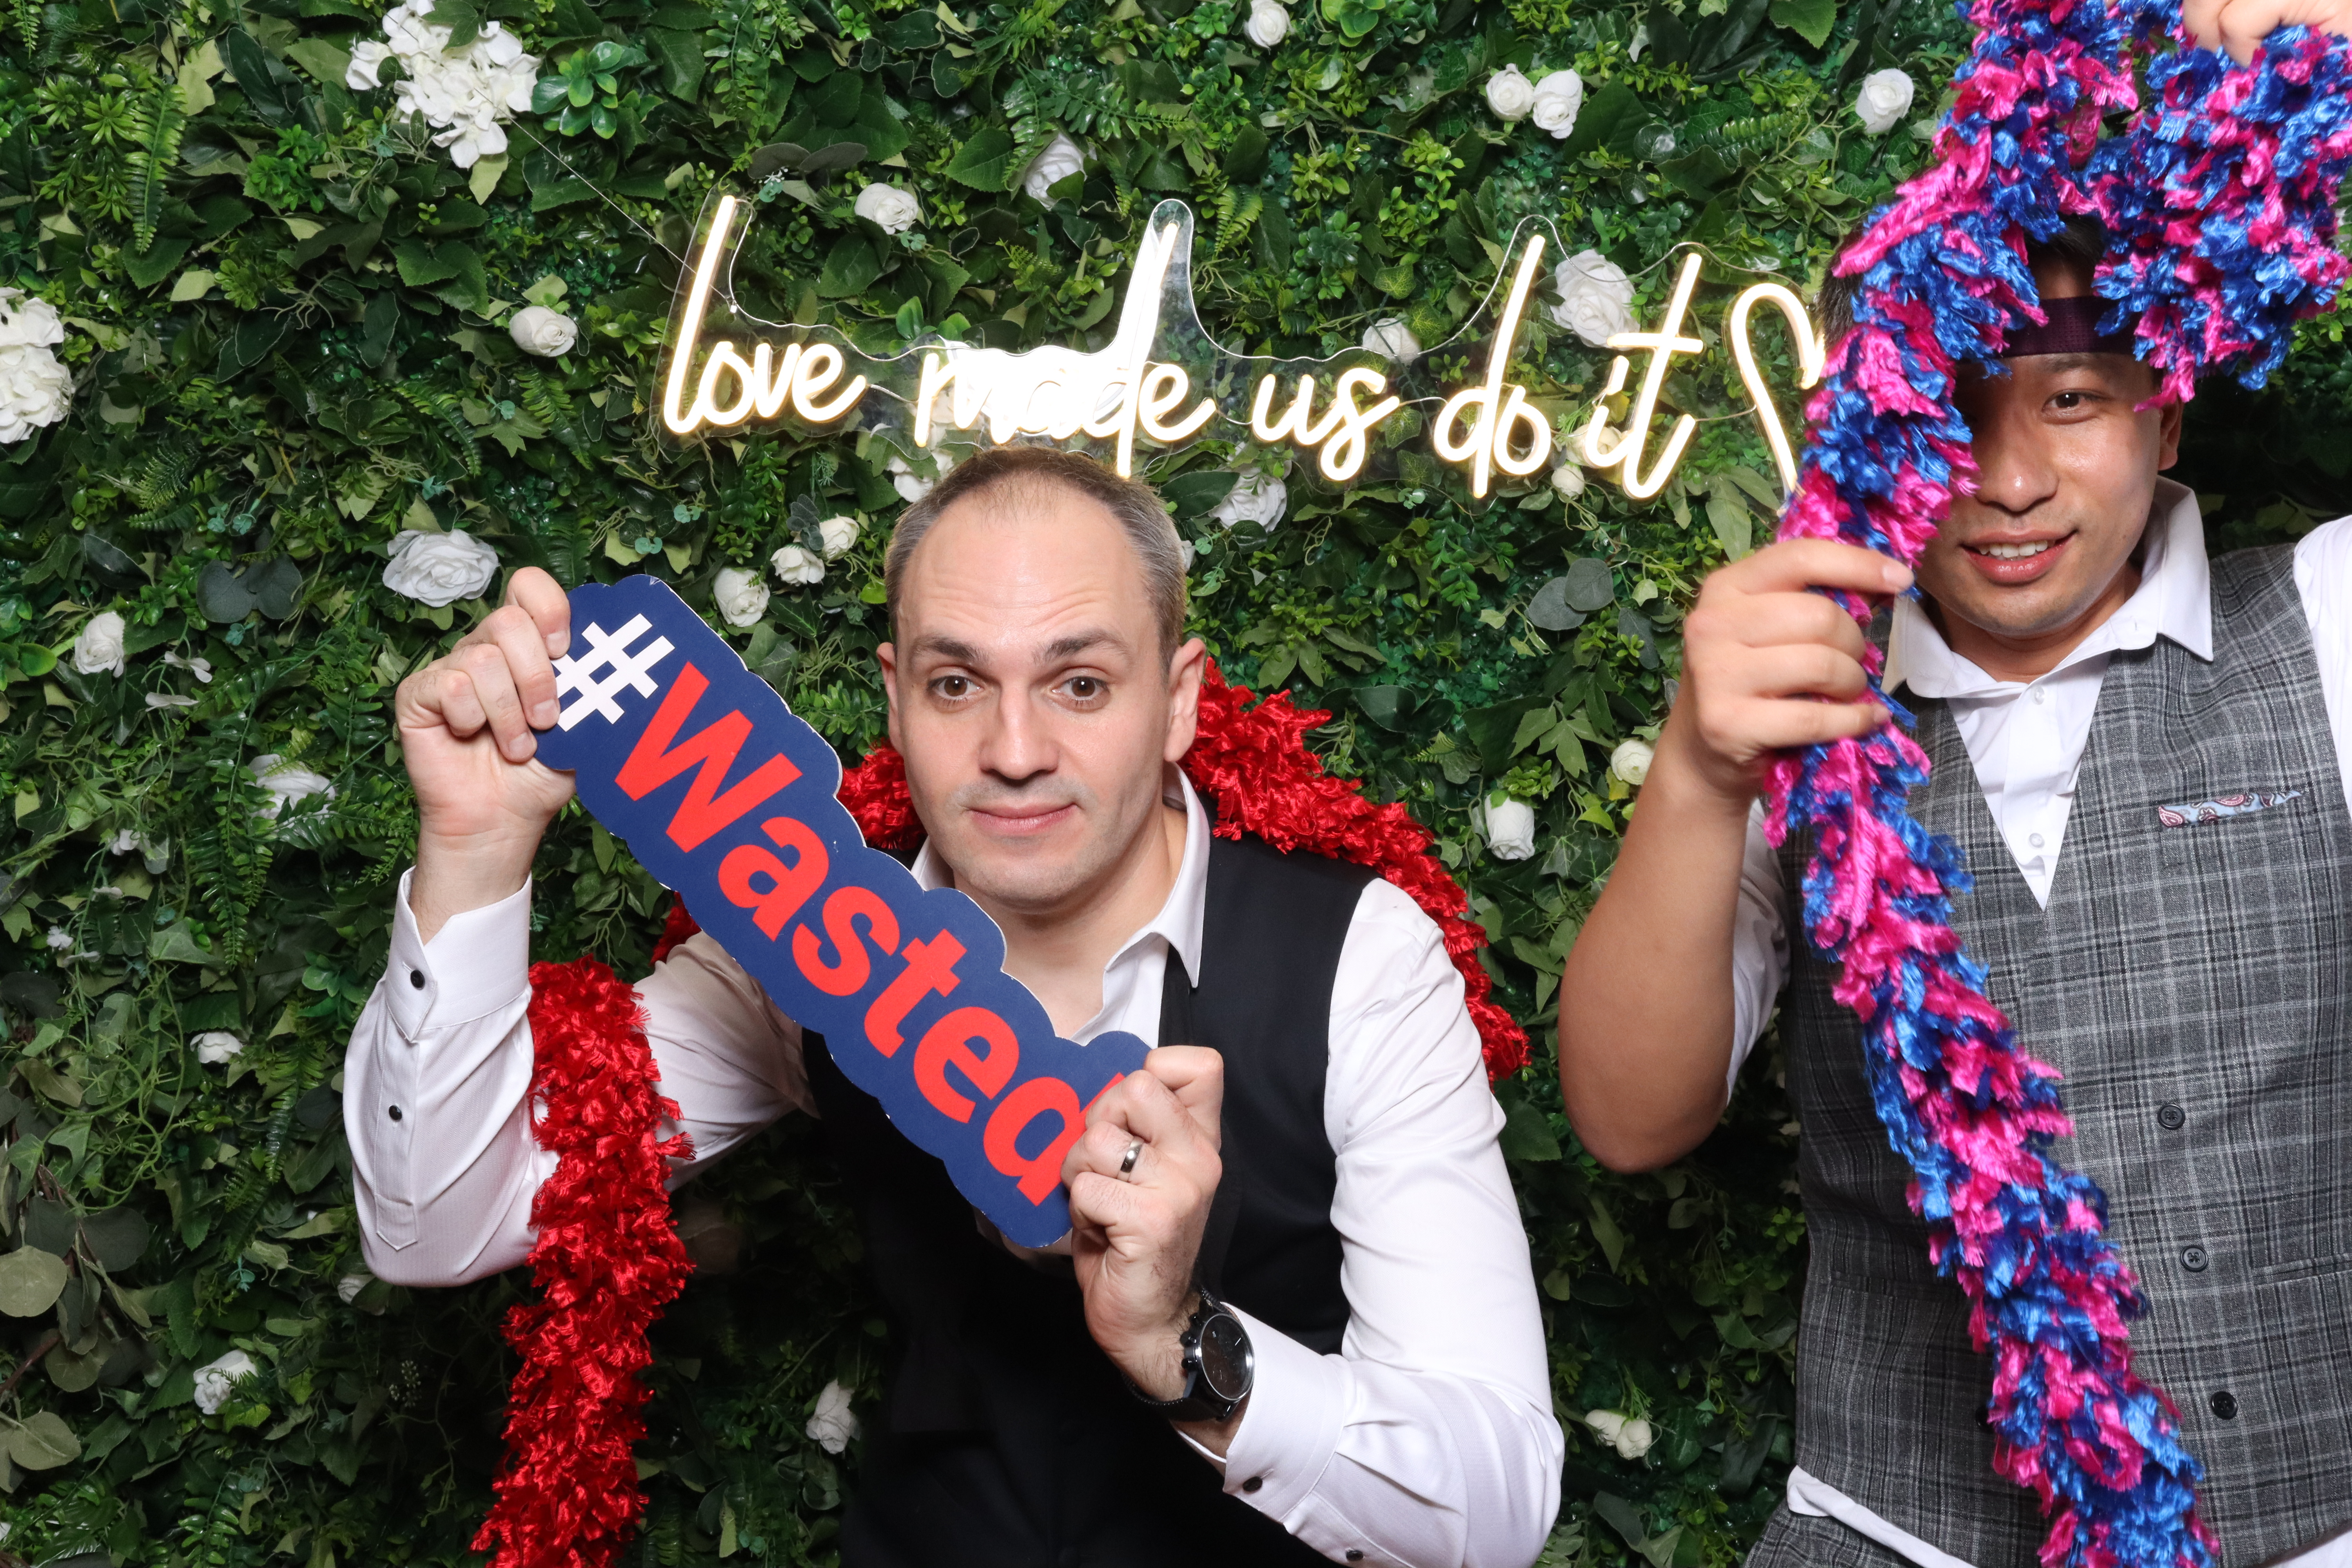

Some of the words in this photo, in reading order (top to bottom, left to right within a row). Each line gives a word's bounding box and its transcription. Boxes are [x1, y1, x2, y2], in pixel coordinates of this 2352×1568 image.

[663, 195, 867, 435] love
[914, 222, 1216, 479] made
[1252, 368, 1400, 481] us
[1434, 234, 1552, 499] do
[1584, 253, 1704, 500] it
[553, 613, 1125, 1207] #Wasted
